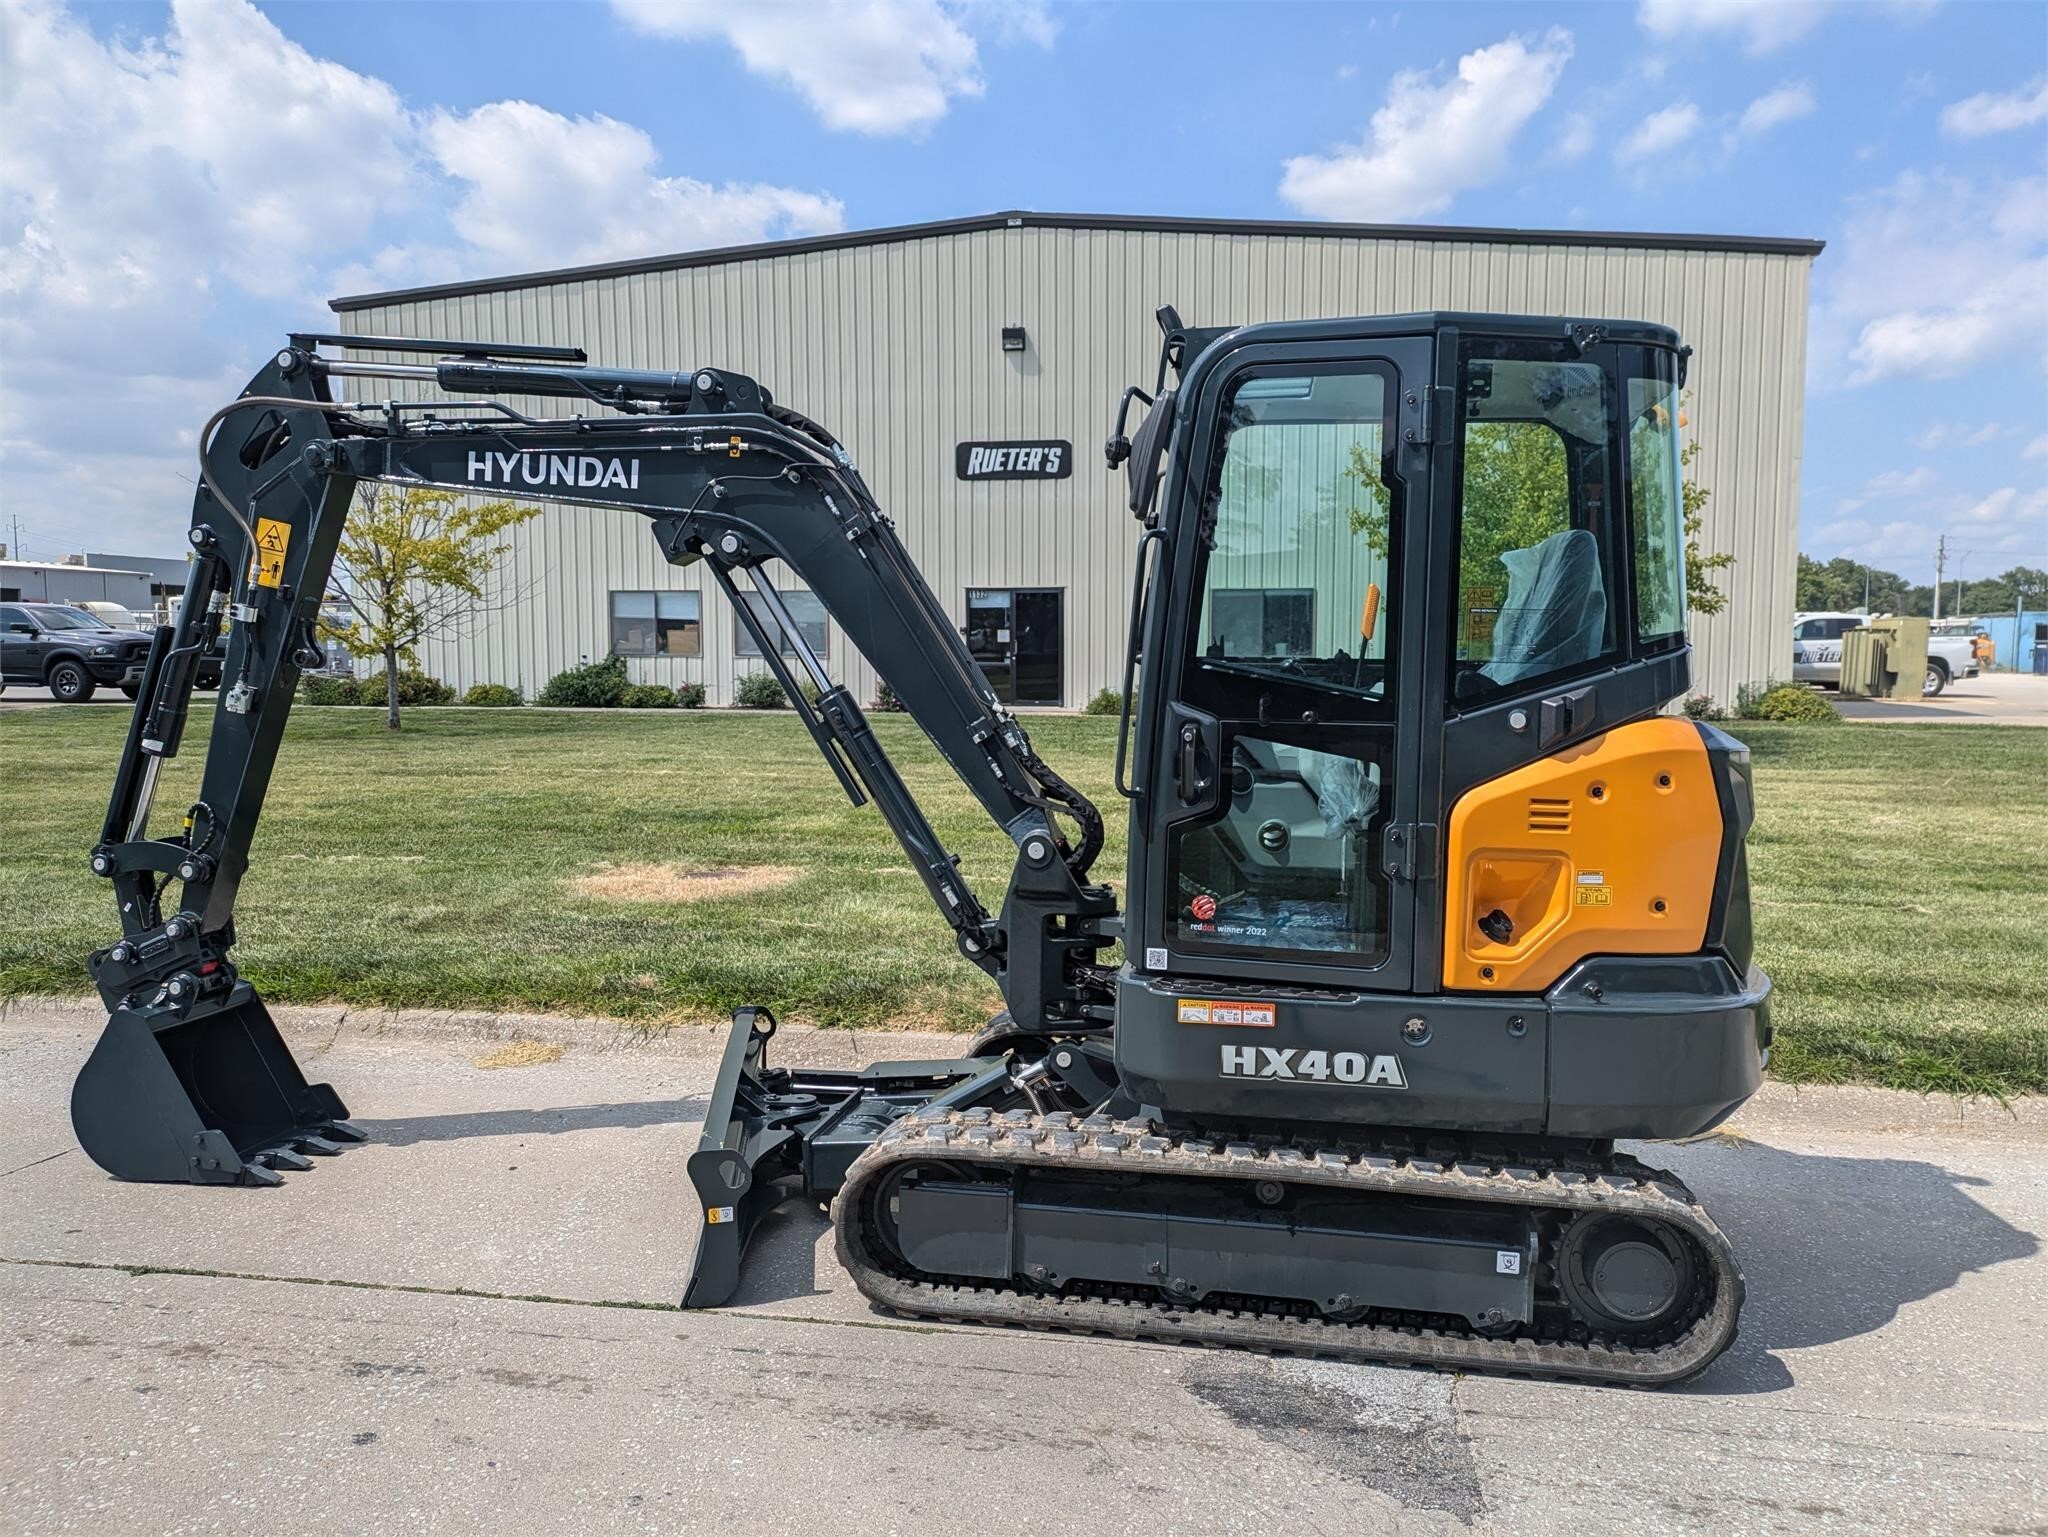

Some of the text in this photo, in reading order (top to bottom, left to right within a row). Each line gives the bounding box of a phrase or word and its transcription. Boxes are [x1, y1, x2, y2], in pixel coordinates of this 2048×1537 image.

[467, 450, 640, 489] HYUNDAI
[967, 447, 1062, 475] RUETER'S
[1800, 650, 1841, 664] RUETER
[1217, 925, 1244, 934] winner
[1246, 927, 1267, 936] 2022
[1221, 1045, 1403, 1086] HX40A
